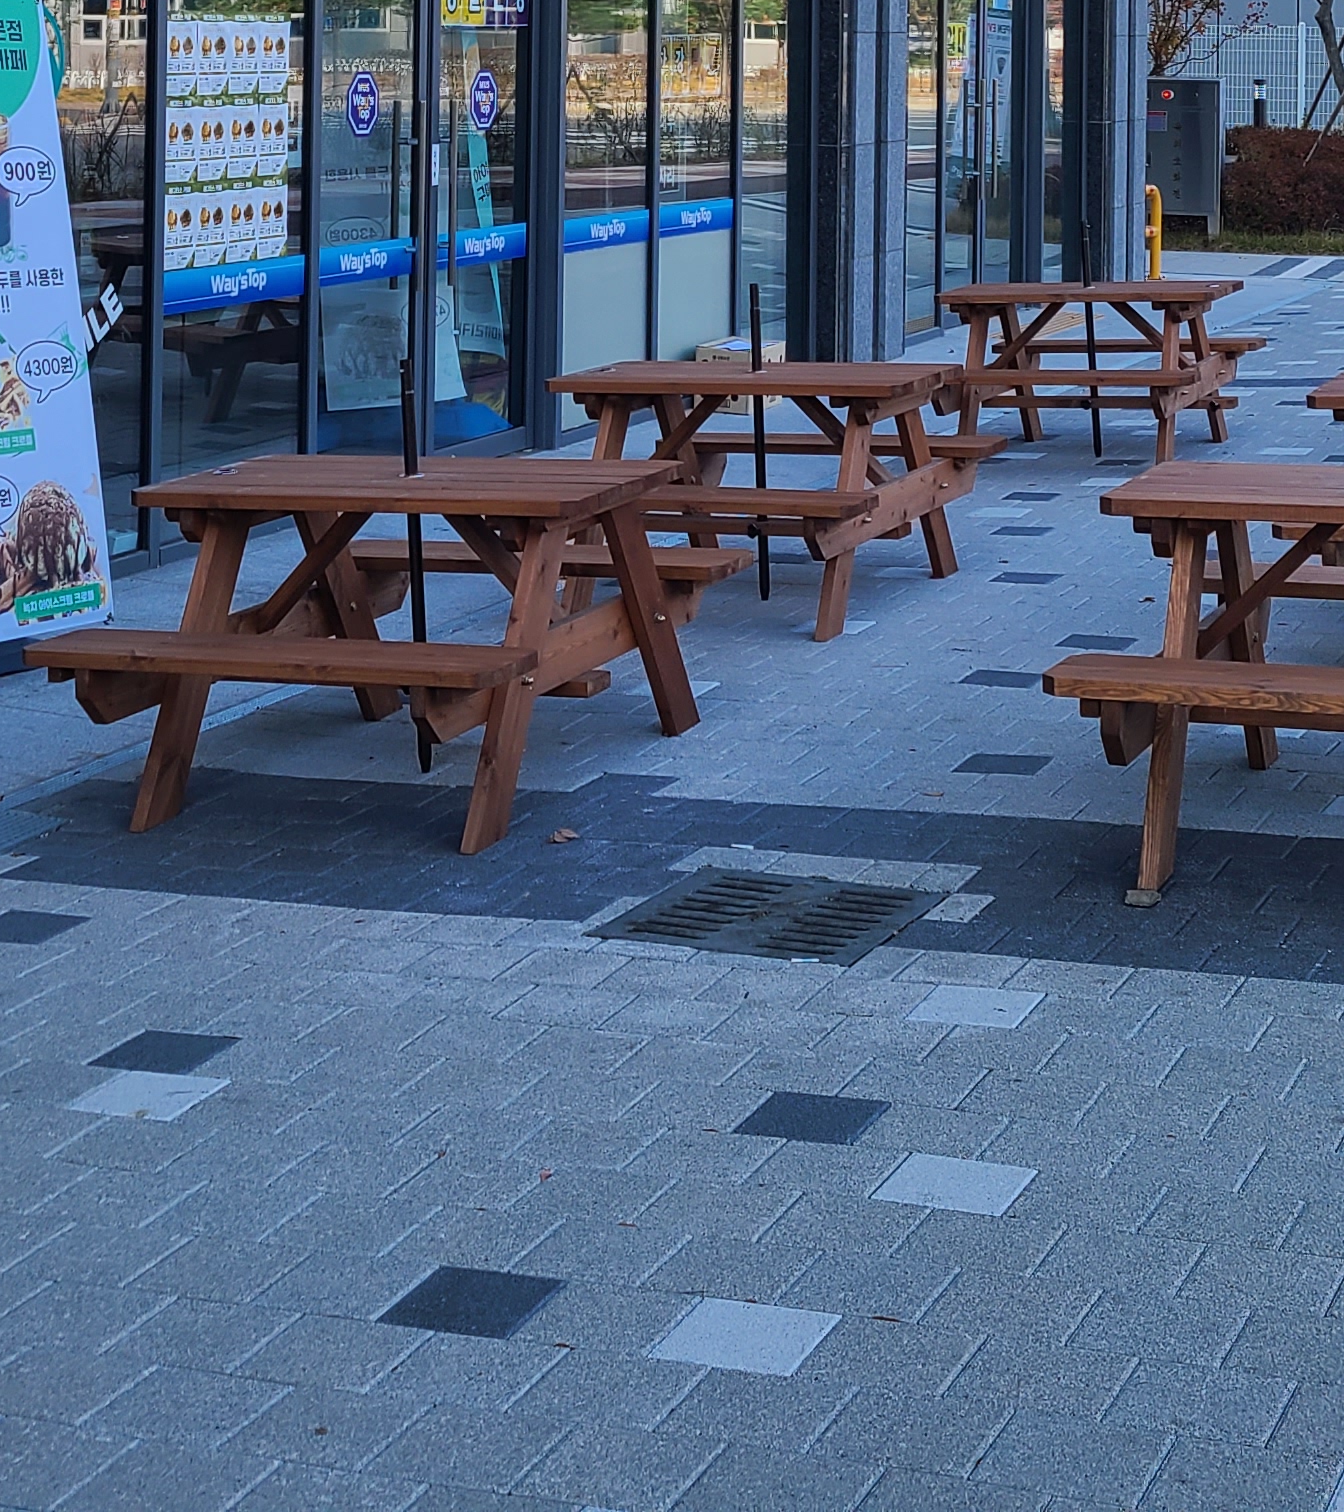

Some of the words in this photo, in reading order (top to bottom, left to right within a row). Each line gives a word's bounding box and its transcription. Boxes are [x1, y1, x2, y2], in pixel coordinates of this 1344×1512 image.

[3, 160, 53, 182] 900원
[26, 267, 64, 288] 사용한
[23, 354, 76, 377] 4300원
